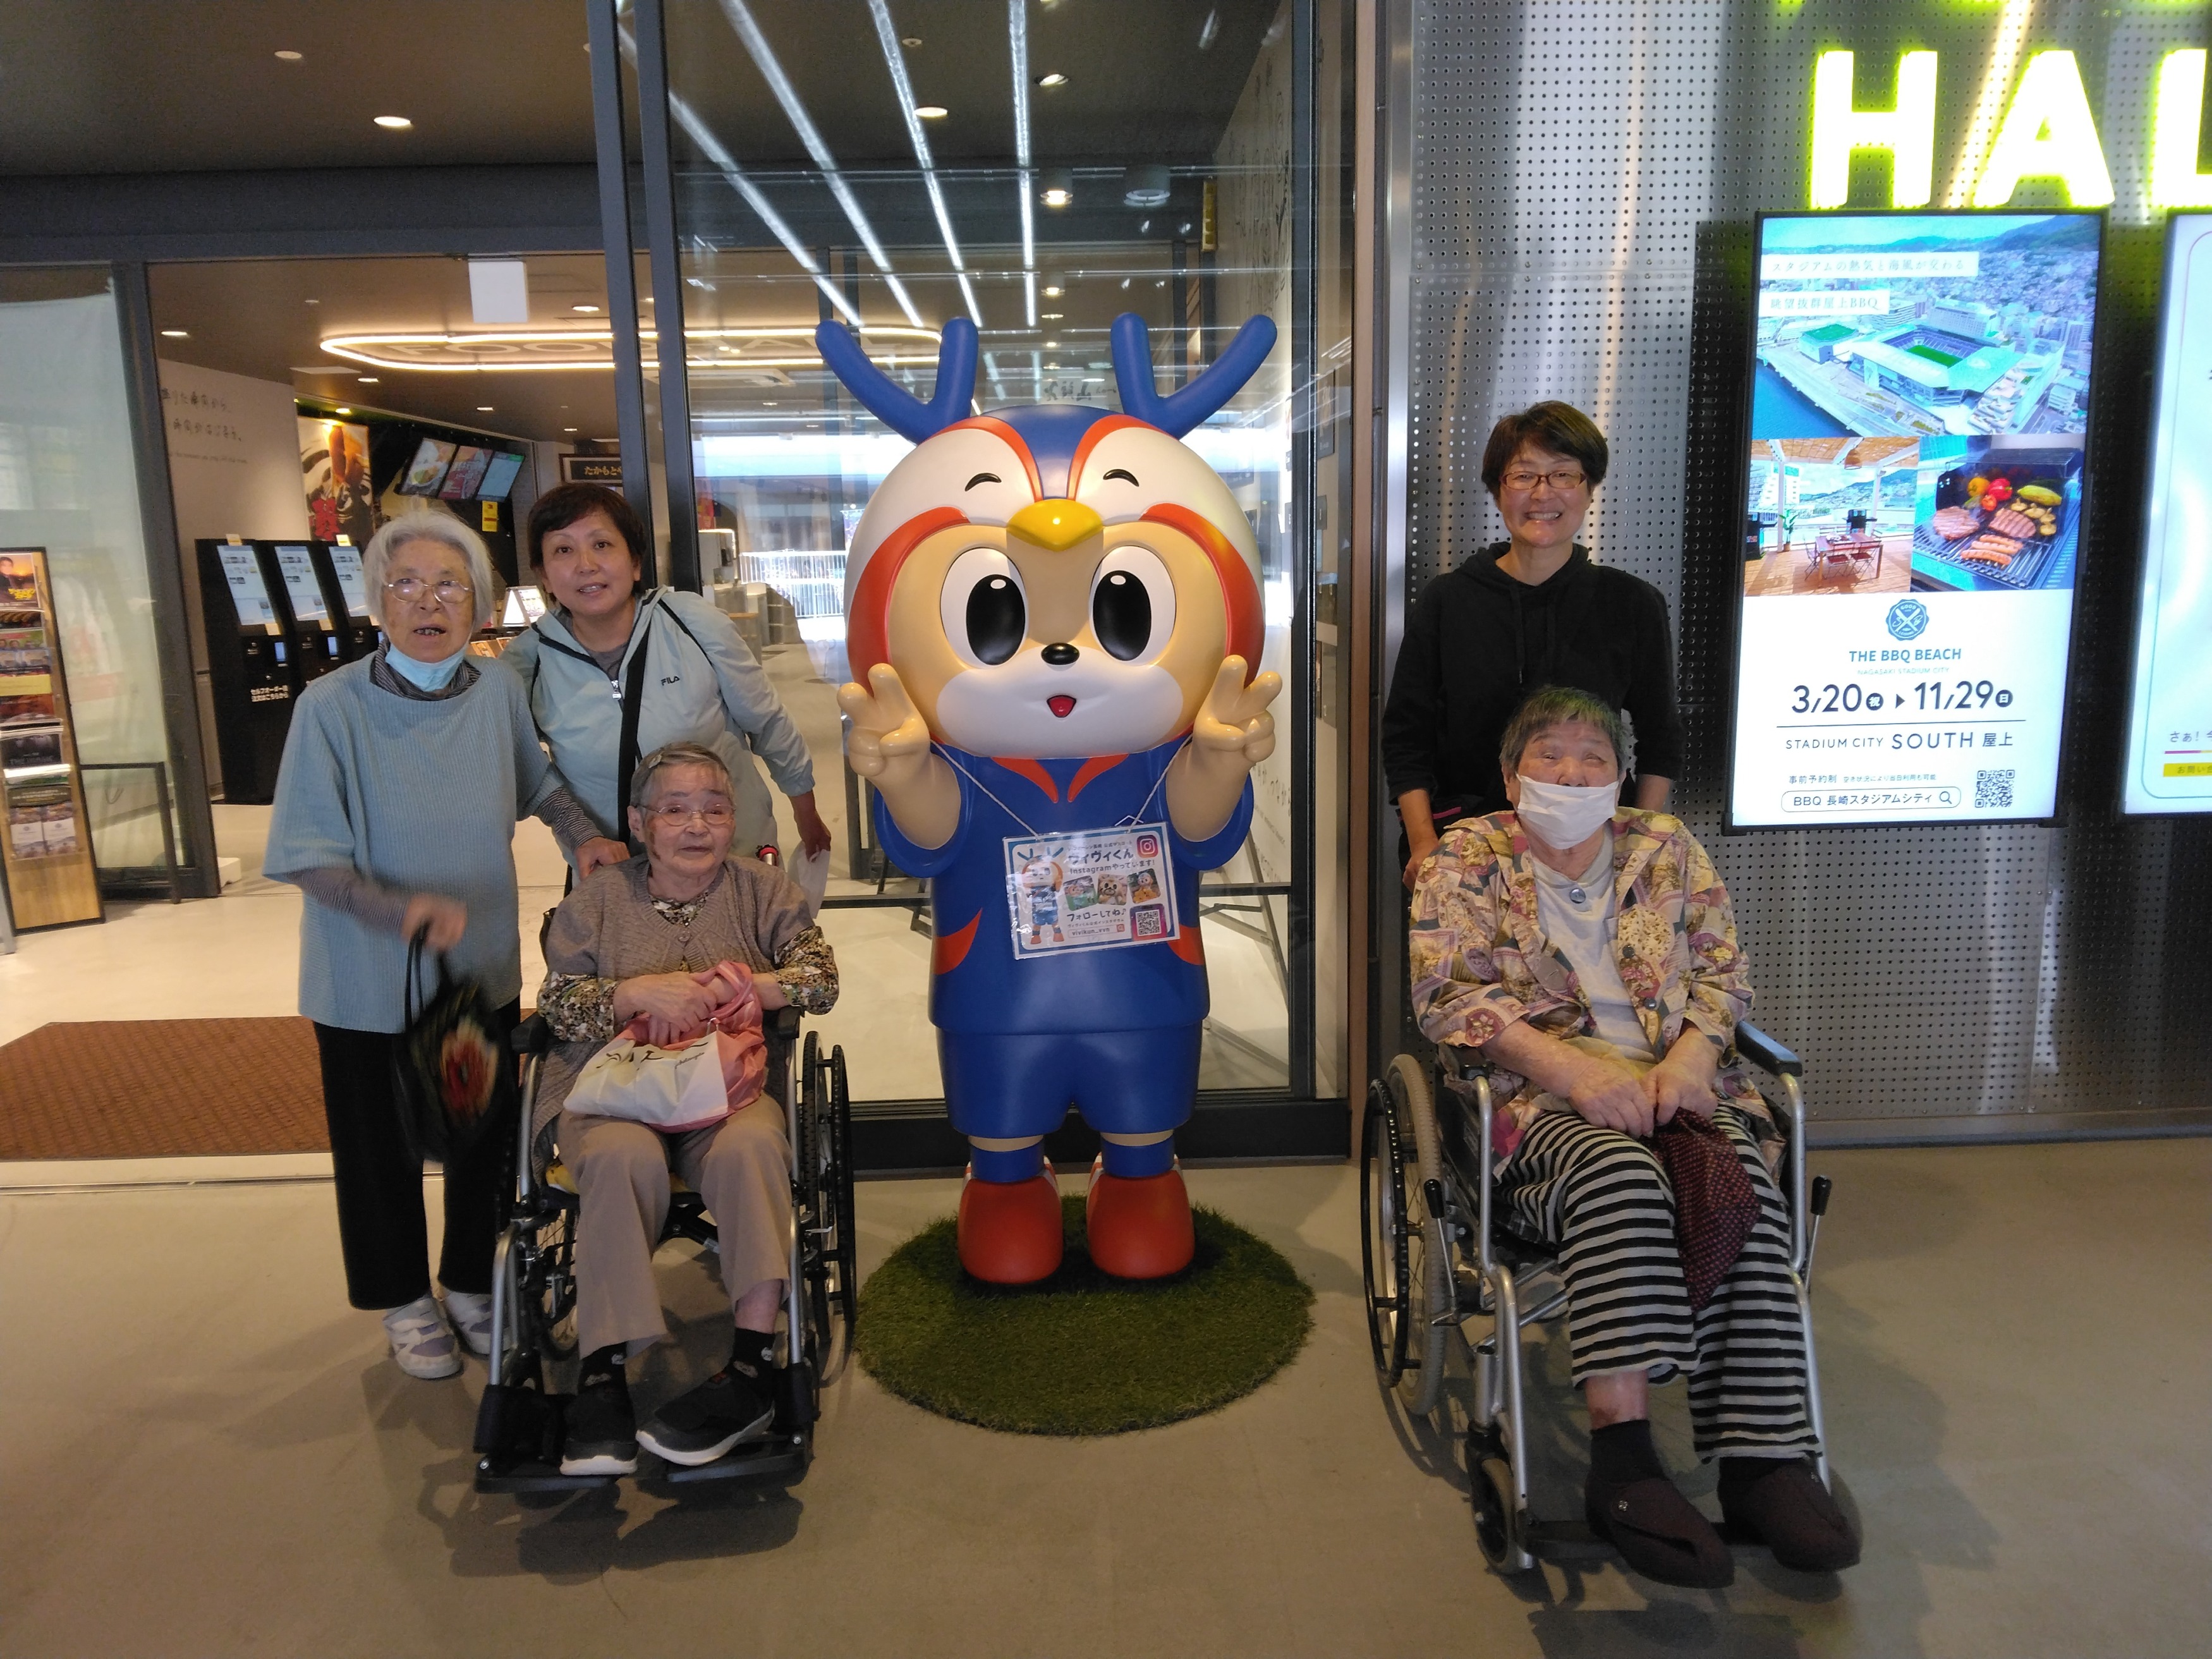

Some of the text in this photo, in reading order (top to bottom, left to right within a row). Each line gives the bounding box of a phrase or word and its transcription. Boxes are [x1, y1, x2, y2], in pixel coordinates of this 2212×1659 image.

[1849, 648, 1962, 663] THE BBQ BEACH
[660, 676, 680, 686] FILA
[1785, 732, 2013, 750] STADIUM CITY SOUTH 屋上
[1789, 775, 1837, 784] 事前予約制
[1794, 793, 1932, 806] BBQ 長崎スタジアムシティ
